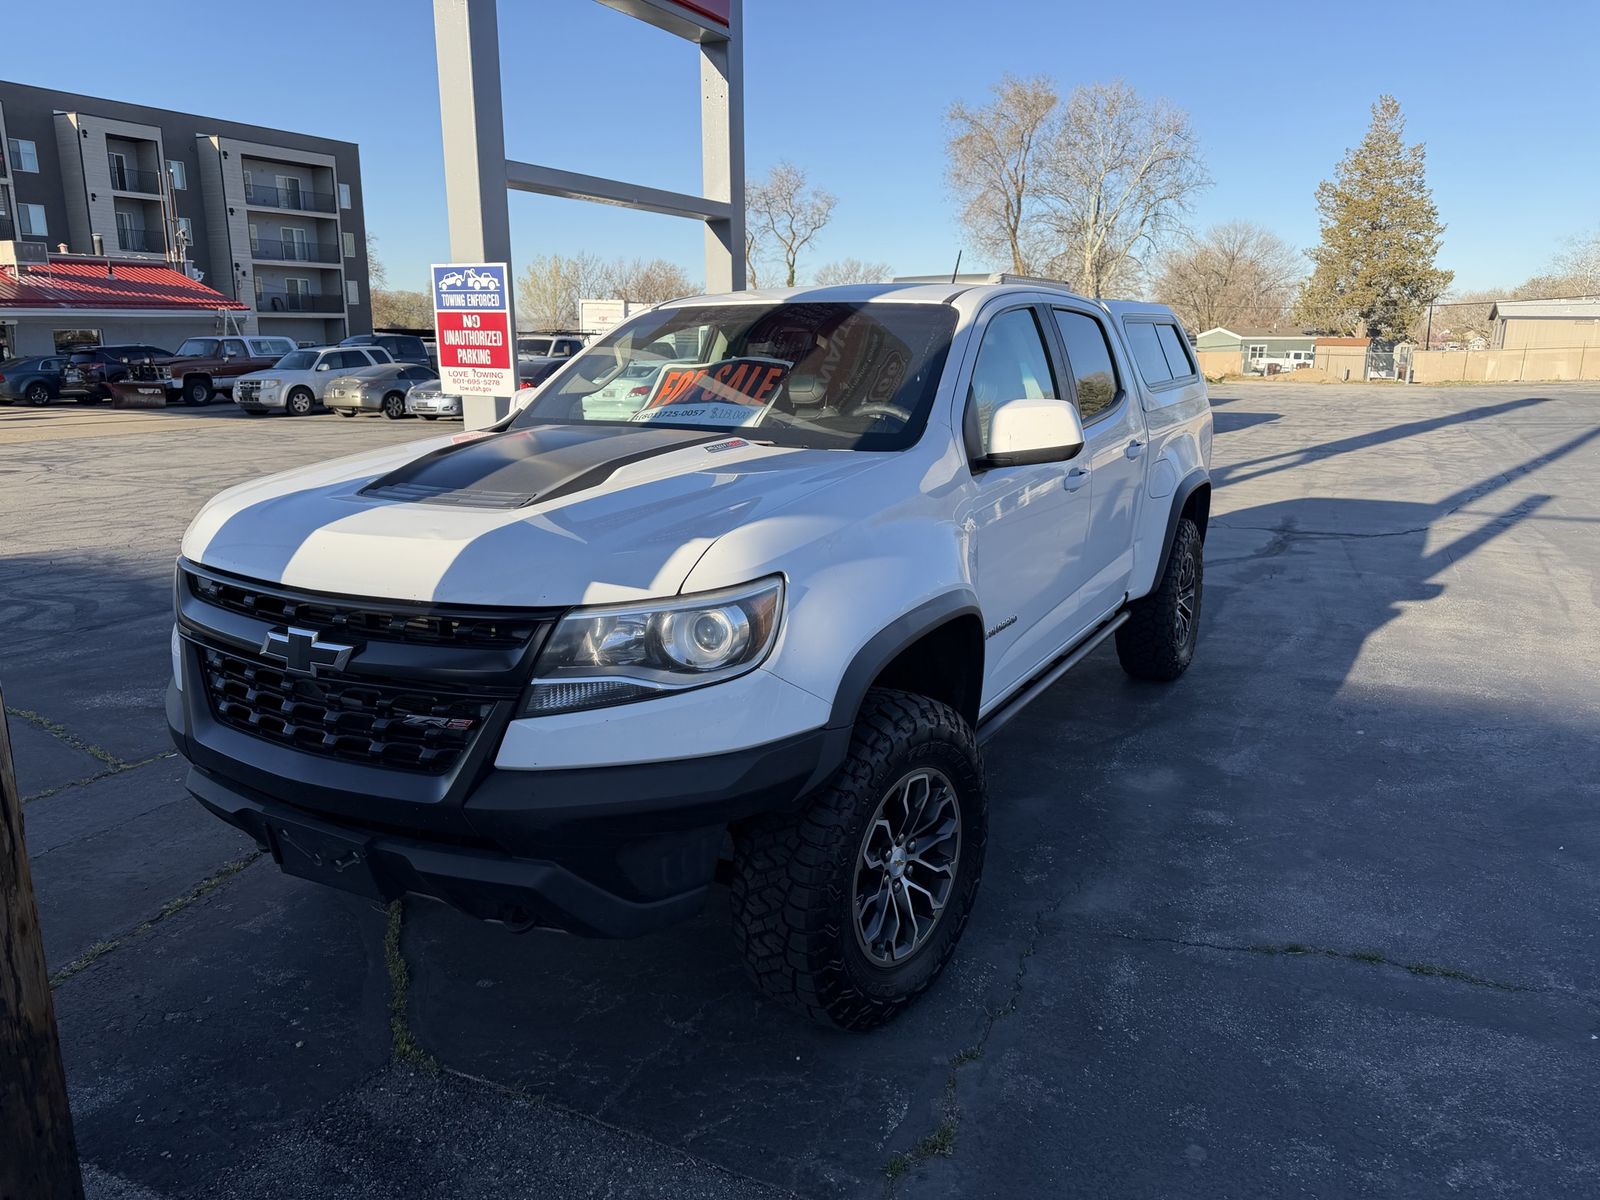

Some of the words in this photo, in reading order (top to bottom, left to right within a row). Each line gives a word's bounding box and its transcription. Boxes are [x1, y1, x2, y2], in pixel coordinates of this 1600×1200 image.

[441, 294, 466, 307] TOWING
[467, 294, 500, 307] ENFORCED
[462, 314, 481, 328] NO
[444, 331, 503, 346] UNAUTHORIZED
[457, 349, 491, 365] PARKING
[448, 370, 469, 378] LOVE
[472, 370, 504, 379] TOWING
[452, 378, 501, 386] 801-695-5278
[651, 369, 709, 408] FOR
[701, 364, 783, 402] SALE
[402, 714, 474, 730] ZR2
